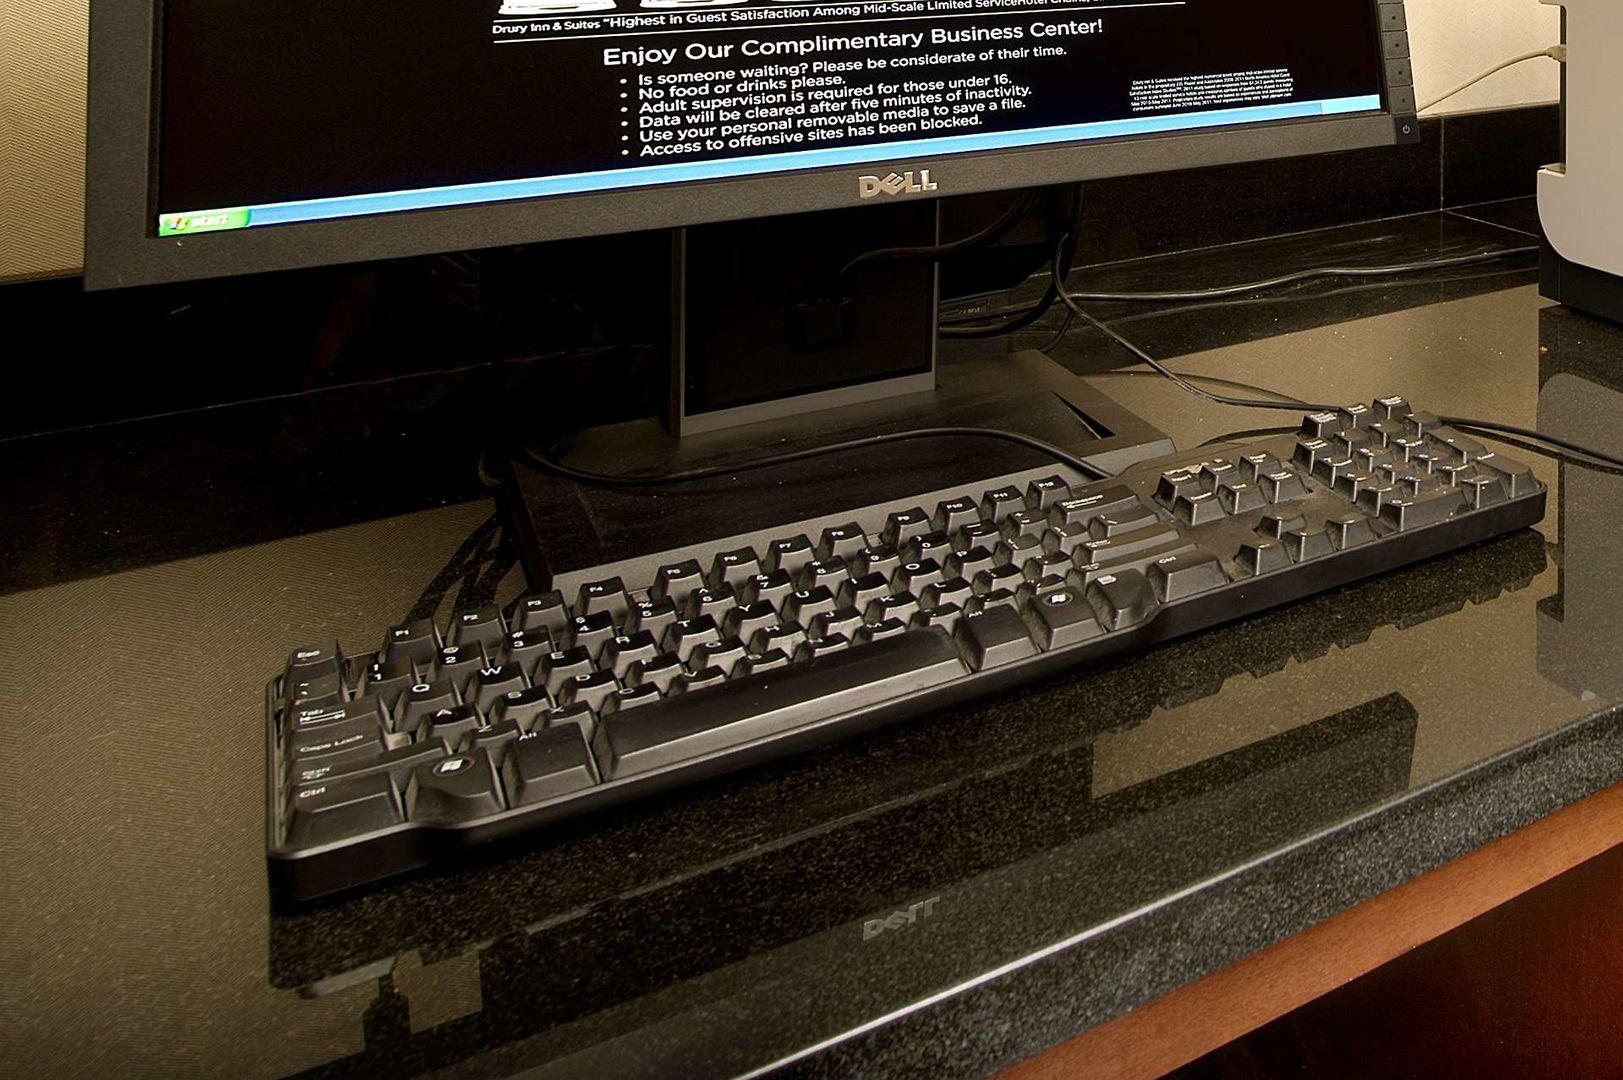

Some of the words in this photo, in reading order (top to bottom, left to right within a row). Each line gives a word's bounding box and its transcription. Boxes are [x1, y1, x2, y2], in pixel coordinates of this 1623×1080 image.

[493, 25, 527, 34] Drury
[531, 23, 550, 31] Inn
[553, 22, 561, 31] &
[564, 21, 600, 30] Suites
[670, 14, 682, 24] in
[686, 12, 727, 23] Guest
[731, 9, 809, 21] Satisfaction
[813, 6, 860, 16] Among
[864, 1, 924, 14] Mid-Scale
[604, 46, 677, 66] Enjoy
[685, 43, 734, 60] Our
[742, 32, 923, 57] Complimentary
[931, 26, 1023, 44] Business
[1030, 19, 1102, 38] Center!
[639, 74, 652, 86] Is
[658, 70, 735, 84] someone
[740, 62, 808, 79] waiting?
[813, 61, 863, 73] Please
[867, 58, 886, 69] be
[890, 52, 975, 67] considerate
[979, 49, 994, 61] of
[998, 47, 1029, 60] their
[1033, 46, 1066, 57] time.
[639, 87, 664, 100] No
[670, 83, 709, 98] food
[714, 83, 732, 94] or
[737, 78, 787, 93] drinks
[792, 76, 845, 90] please.
[639, 99, 687, 114] Adult
[692, 92, 786, 110] supervision
[792, 90, 804, 102] is
[808, 84, 873, 100] required
[878, 83, 899, 94] for
[904, 81, 944, 92] those
[949, 76, 990, 88] under
[994, 73, 1011, 85] 16.
[640, 115, 680, 128] Data
[686, 110, 714, 124] will
[720, 109, 740, 121] be
[745, 103, 805, 119] cleared
[810, 101, 847, 114] after
[851, 98, 879, 110] five
[883, 94, 942, 107] minutes
[946, 90, 961, 102] of
[965, 85, 1031, 100] inactivity.
[640, 129, 673, 142] Use
[678, 127, 716, 141] your
[722, 117, 791, 137] personal
[797, 110, 879, 128] removable
[884, 106, 929, 120] media
[933, 105, 949, 116] to
[953, 103, 985, 114] save
[989, 101, 997, 111] a
[1001, 98, 1025, 110] file.
[640, 142, 701, 157] Access
[706, 139, 724, 151] to
[729, 132, 803, 148] offensive
[808, 128, 843, 141] sites
[848, 126, 874, 137] has
[879, 122, 916, 134] been
[921, 113, 982, 130] blocked.
[858, 169, 938, 198] DELL
